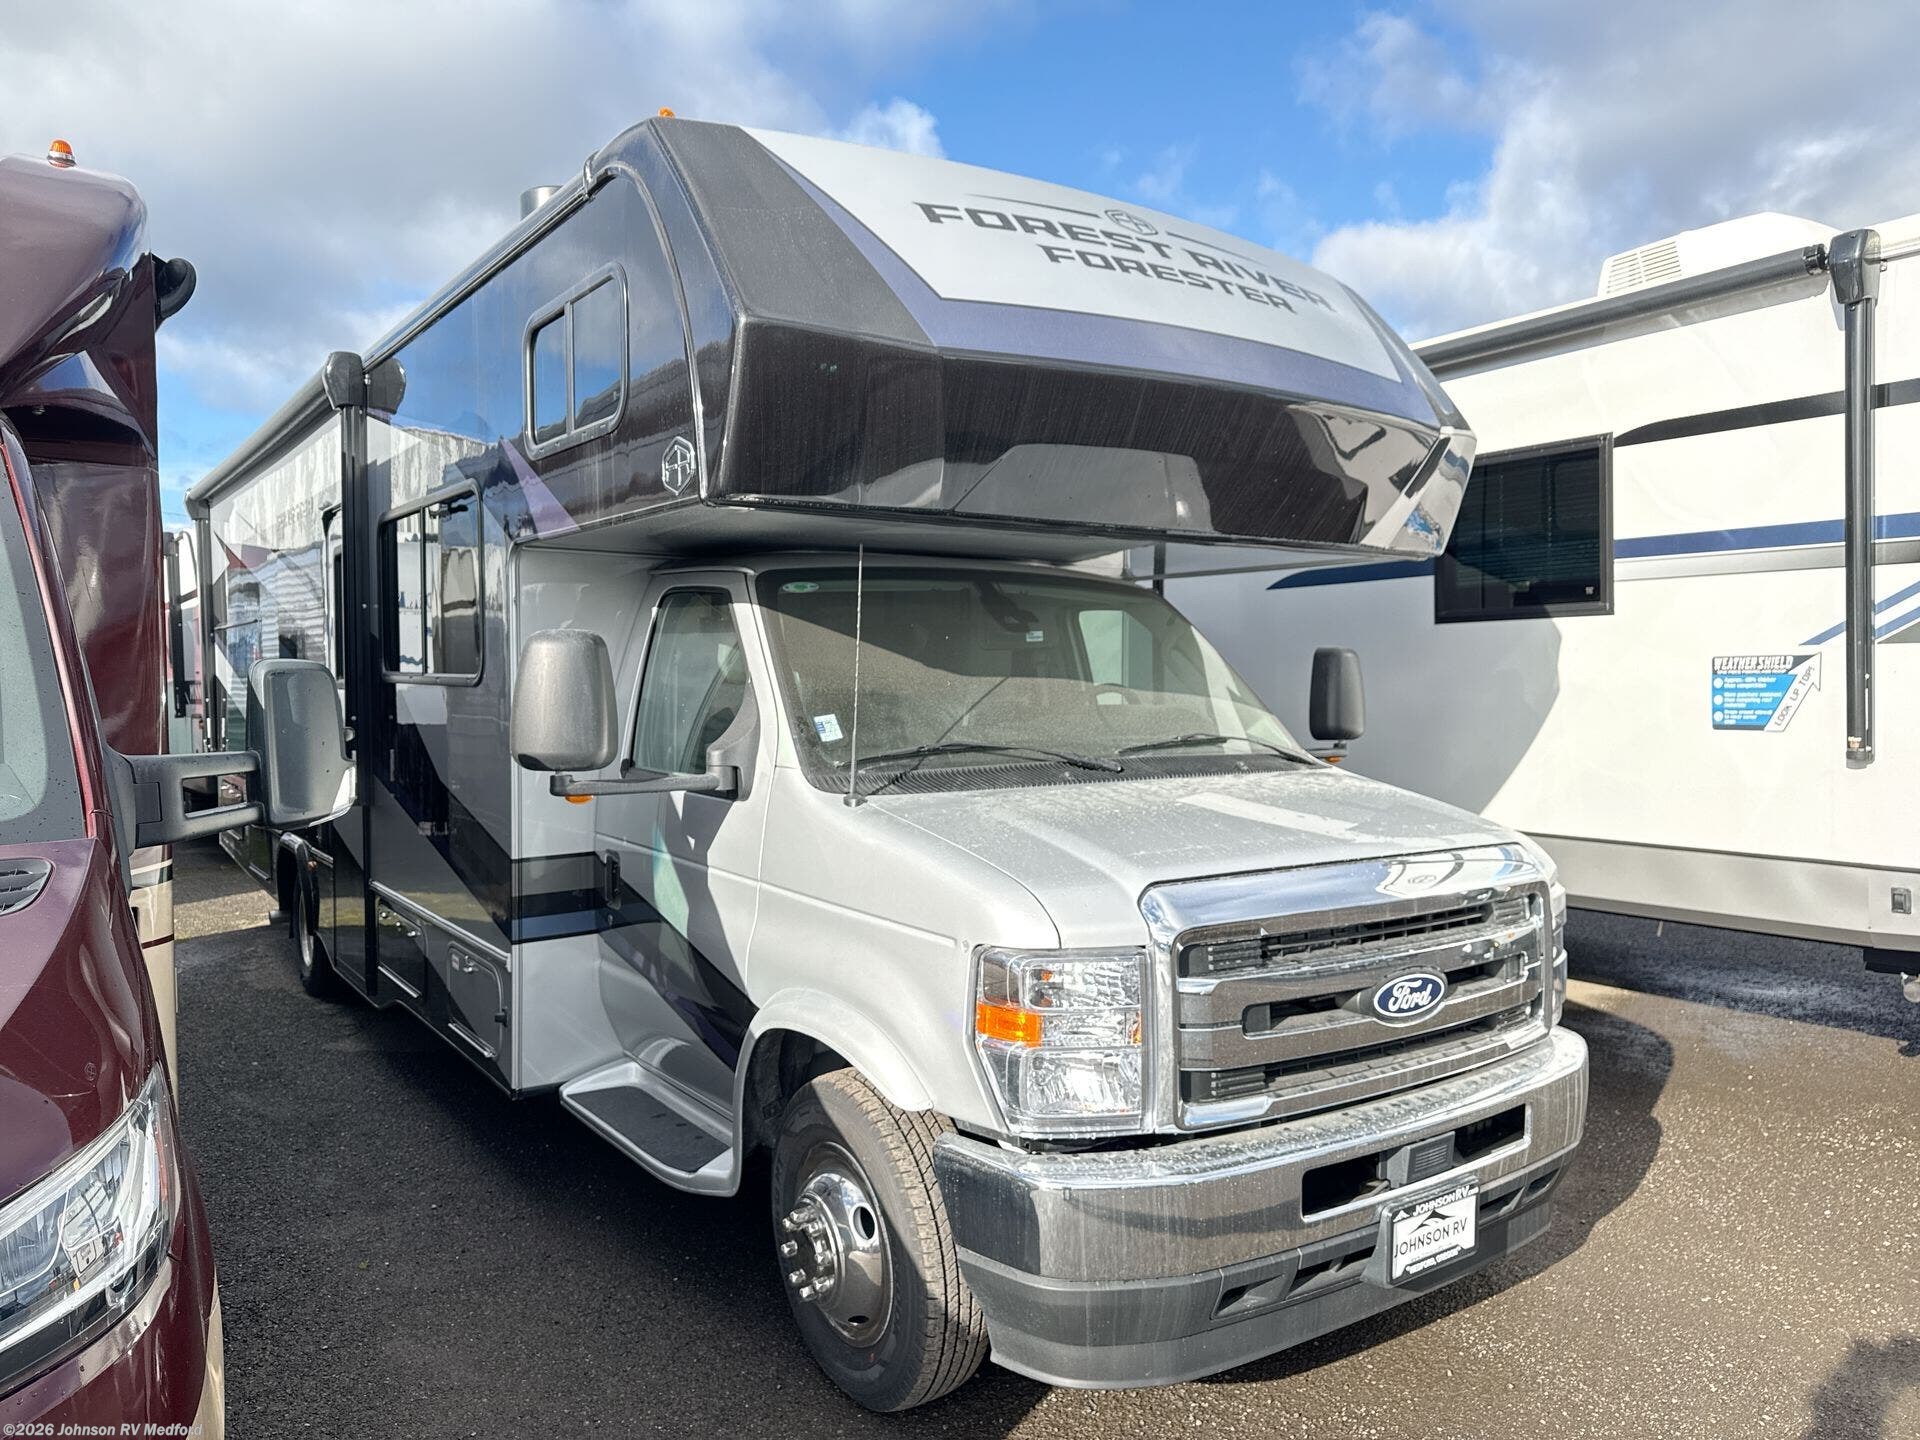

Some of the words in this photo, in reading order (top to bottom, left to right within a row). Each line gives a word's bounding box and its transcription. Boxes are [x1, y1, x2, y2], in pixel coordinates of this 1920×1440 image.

[914, 202, 1174, 259] FOREST
[1182, 248, 1337, 313] RIVER
[1036, 244, 1298, 314] FORESTER
[1713, 656, 1757, 671] WEATHER
[1757, 655, 1794, 671] SHIELD
[1774, 704, 1792, 726] LOOK
[1789, 688, 1800, 702] UP
[1388, 980, 1433, 1012] Ford
[1394, 1224, 1451, 1259] JOHNSON
[1453, 1217, 1468, 1236] RV
